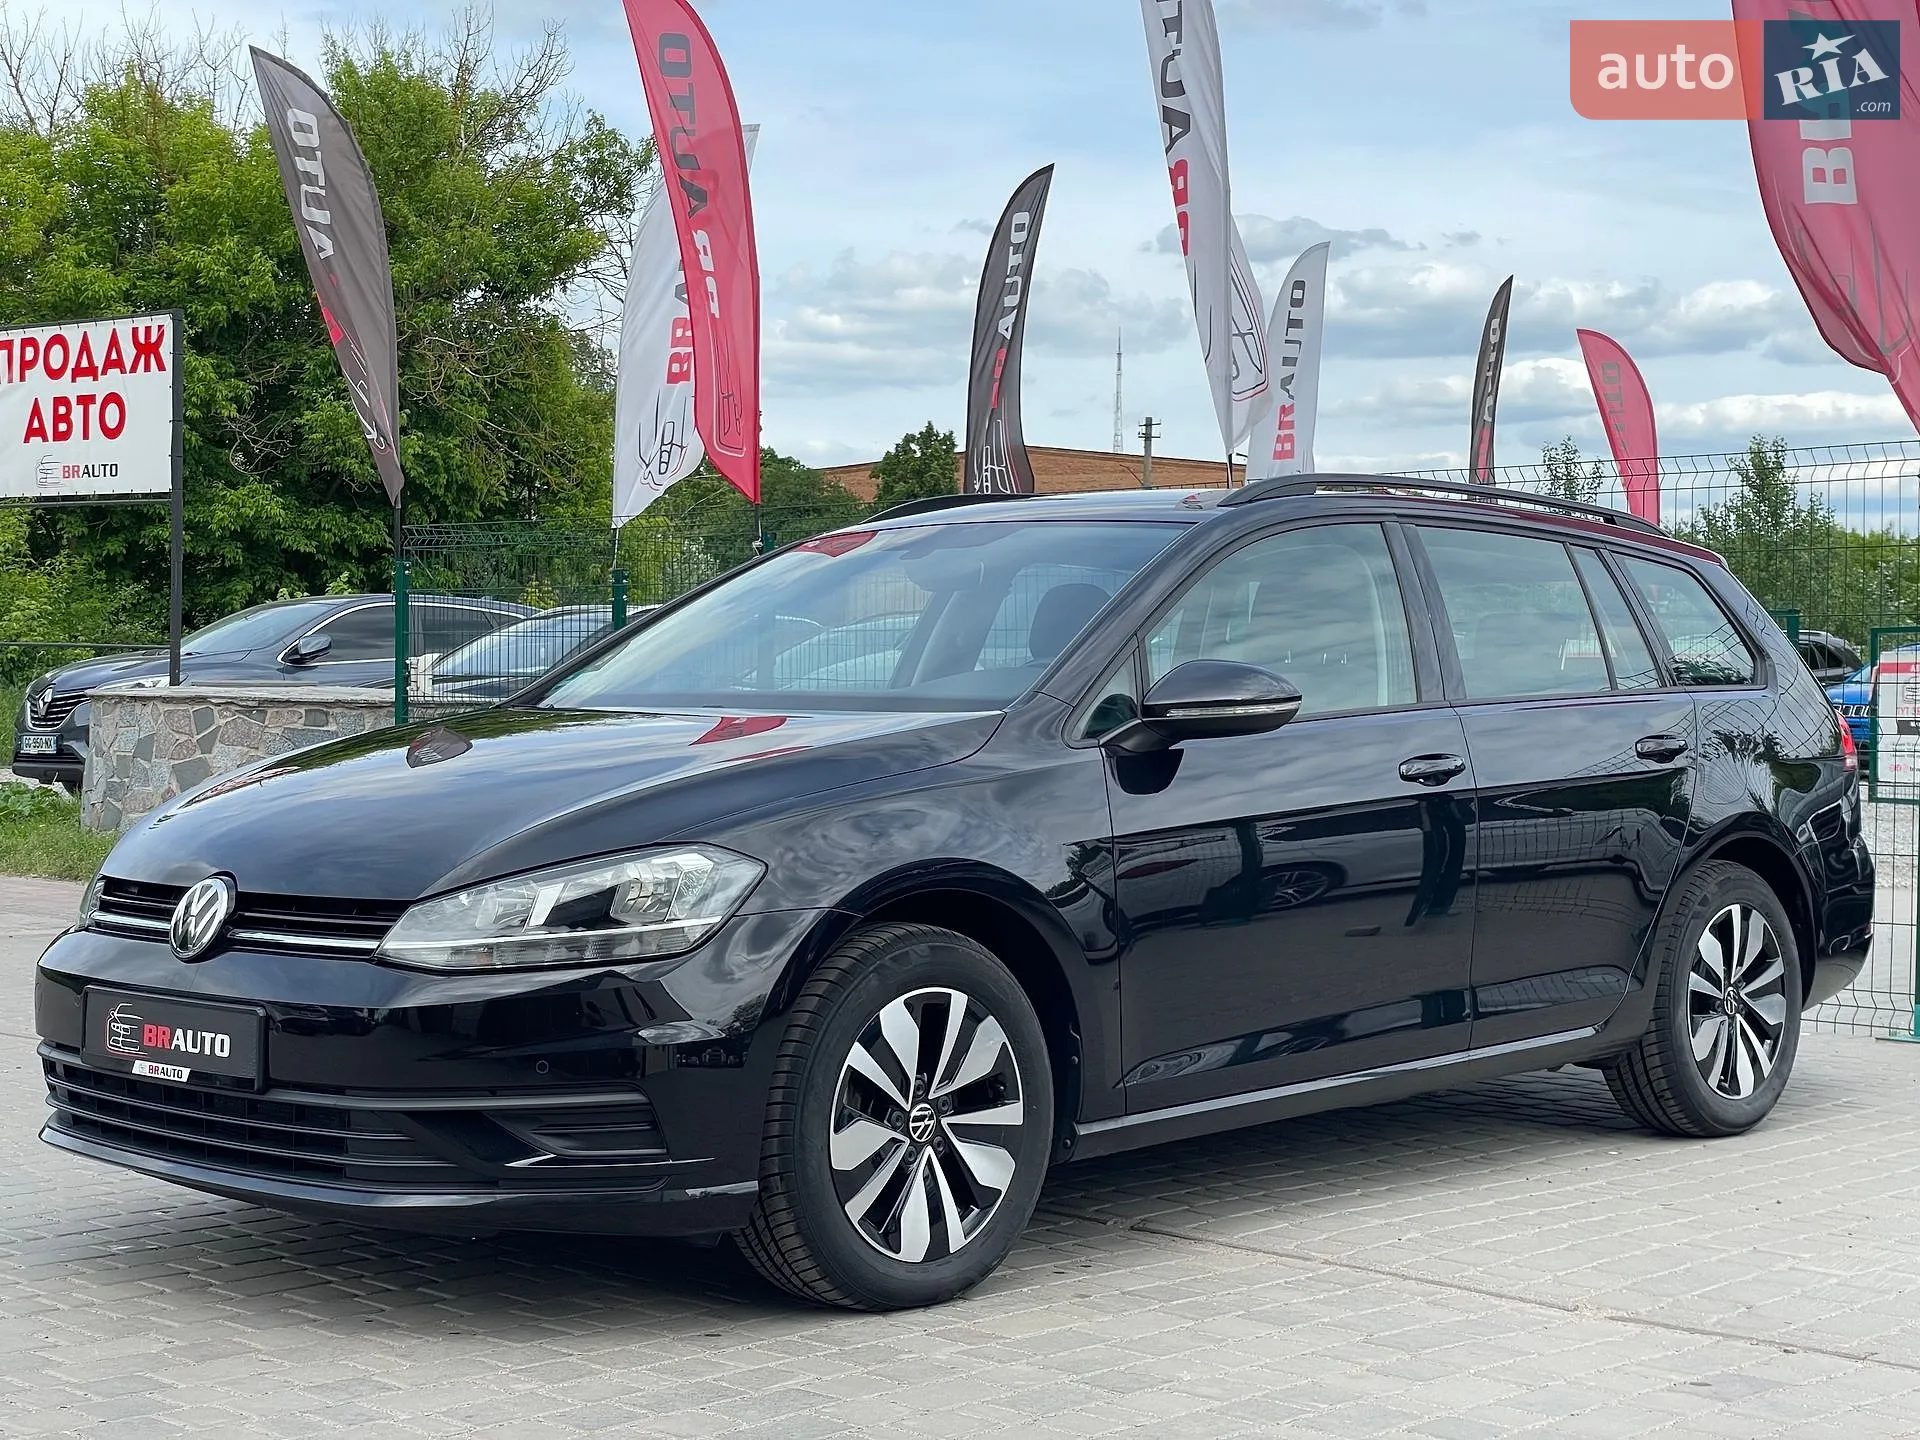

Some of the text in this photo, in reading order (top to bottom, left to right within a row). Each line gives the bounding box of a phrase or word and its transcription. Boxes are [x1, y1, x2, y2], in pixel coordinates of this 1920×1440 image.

[0, 325, 167, 384] ПРОДАЖ
[1272, 279, 1306, 460] BRAUTO
[23, 391, 127, 444] АВТО
[62, 463, 118, 479] BRAUTO
[142, 1023, 231, 1059] BRAUTO
[147, 1064, 183, 1080] BRAUTO
